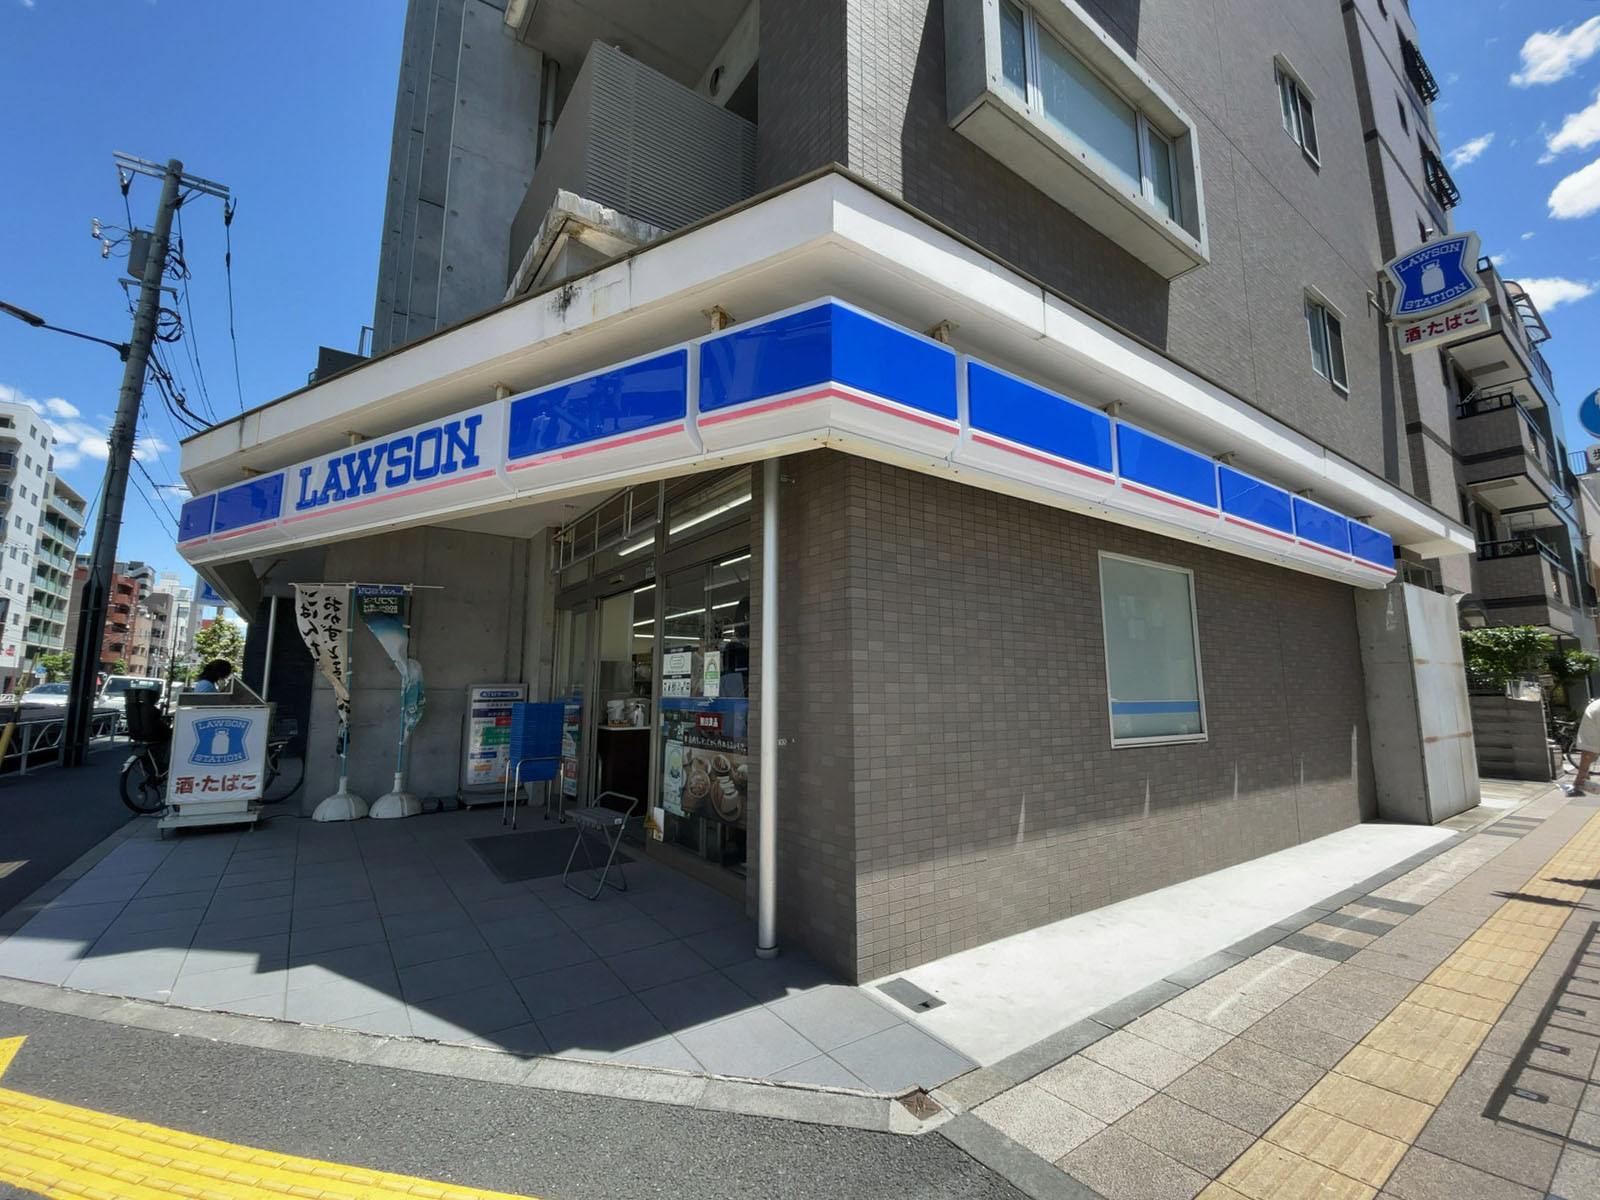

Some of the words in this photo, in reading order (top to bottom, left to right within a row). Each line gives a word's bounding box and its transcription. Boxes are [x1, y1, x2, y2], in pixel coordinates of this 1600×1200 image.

[1397, 242, 1462, 273] LAWSON
[1404, 282, 1468, 309] STATION
[1404, 308, 1480, 343] 酒・たばこ
[296, 414, 483, 511] LAWSON
[197, 720, 248, 730] LAWSON
[194, 752, 244, 763] STATION
[174, 774, 258, 795] 酒・たばこ
